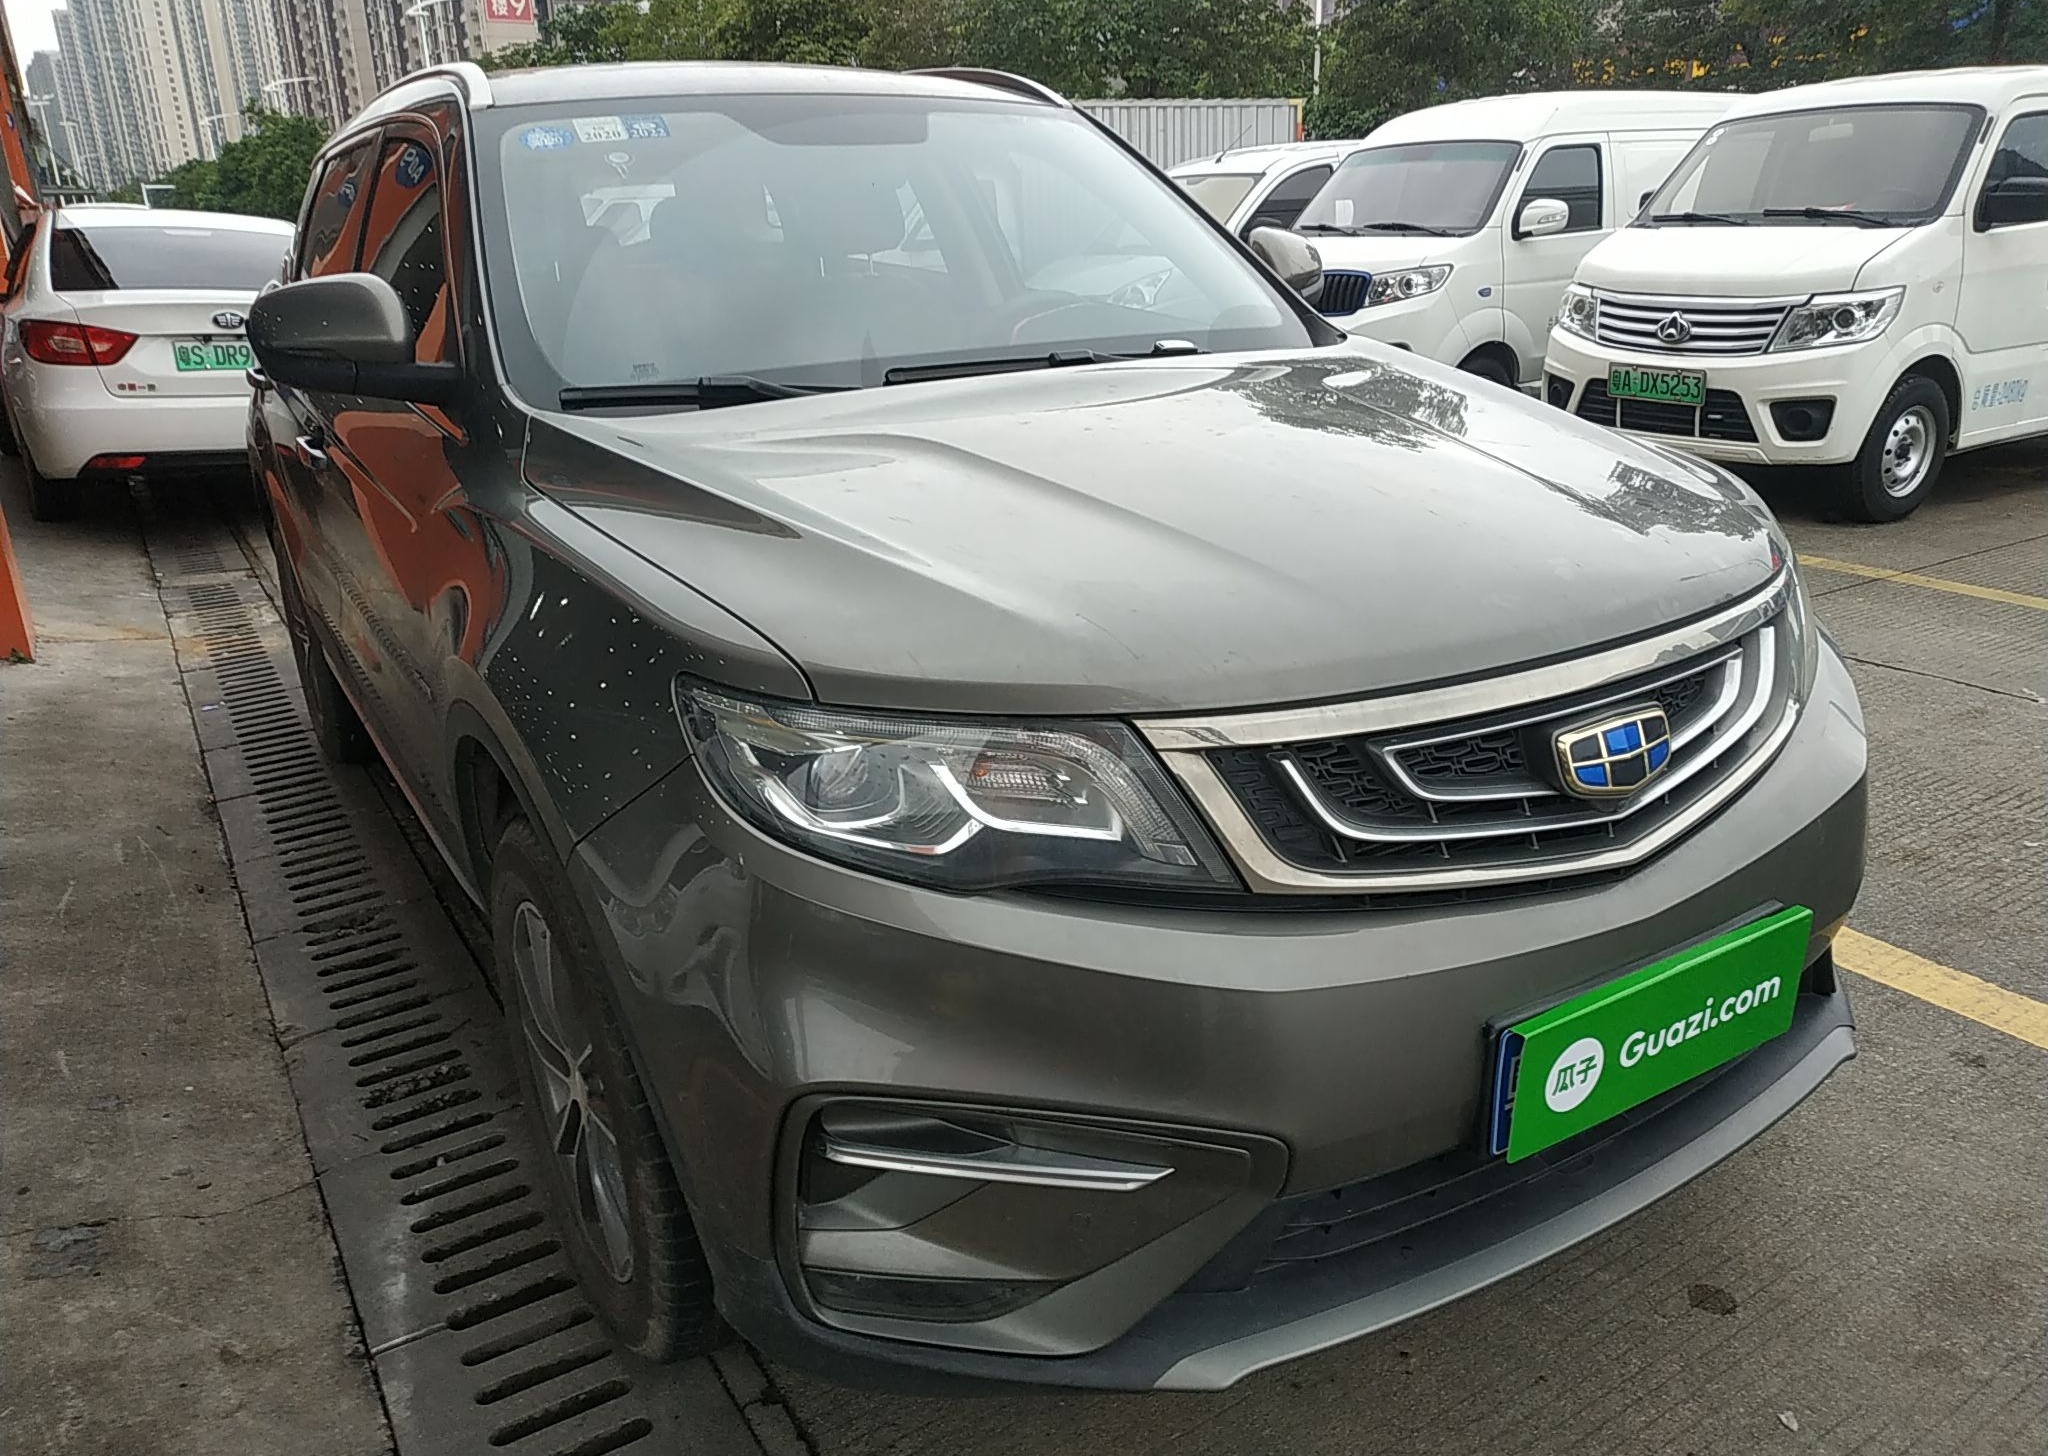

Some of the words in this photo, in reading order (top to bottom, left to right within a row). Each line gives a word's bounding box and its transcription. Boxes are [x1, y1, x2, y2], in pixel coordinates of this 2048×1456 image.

[584, 129, 622, 141] 2020
[1551, 1054, 1598, 1096] 瓜子
[1619, 976, 1781, 1068] Guazi.com
